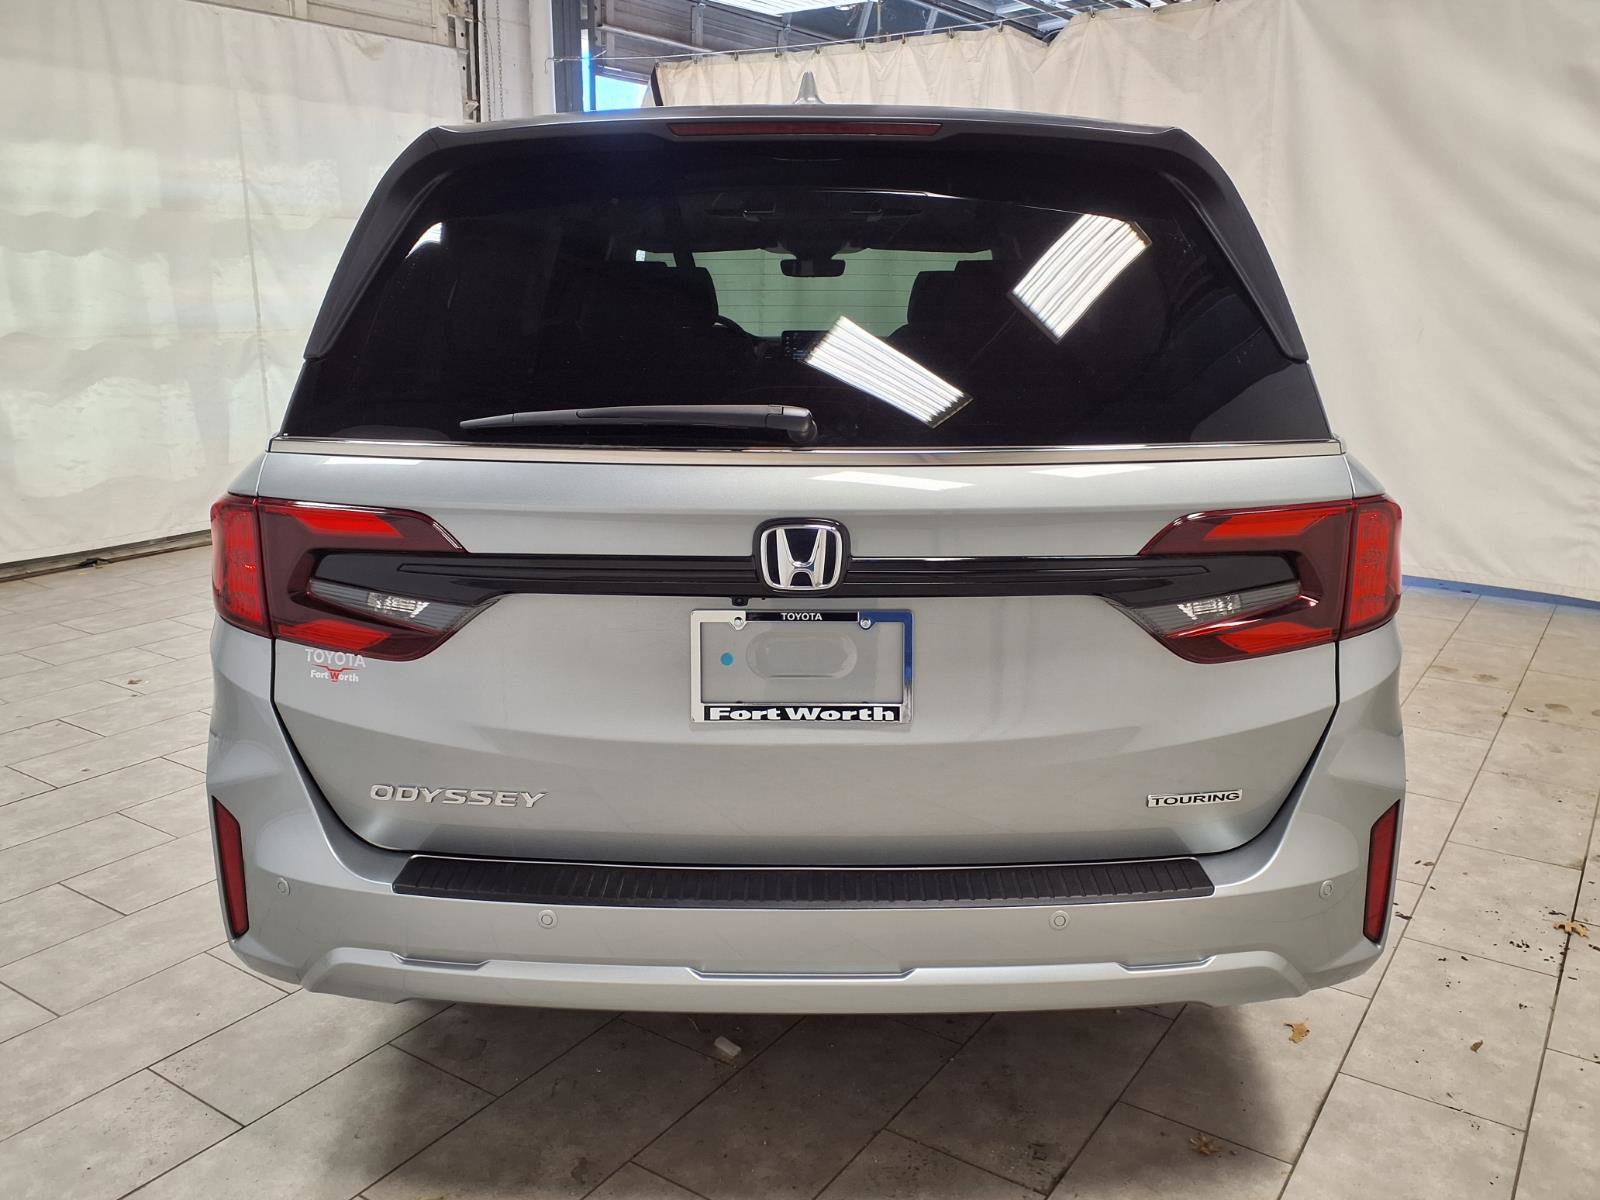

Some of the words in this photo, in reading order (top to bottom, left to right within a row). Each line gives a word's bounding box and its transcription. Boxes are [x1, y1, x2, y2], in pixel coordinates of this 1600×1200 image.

[780, 612, 822, 621] TOYOTA
[305, 648, 366, 668] TOYOTA
[310, 669, 328, 679] Fort
[330, 671, 359, 682] Worth
[709, 706, 781, 721] Fort
[784, 706, 895, 721] Worth
[370, 784, 549, 808] ODYSSEY
[1152, 792, 1240, 806] TOURING
